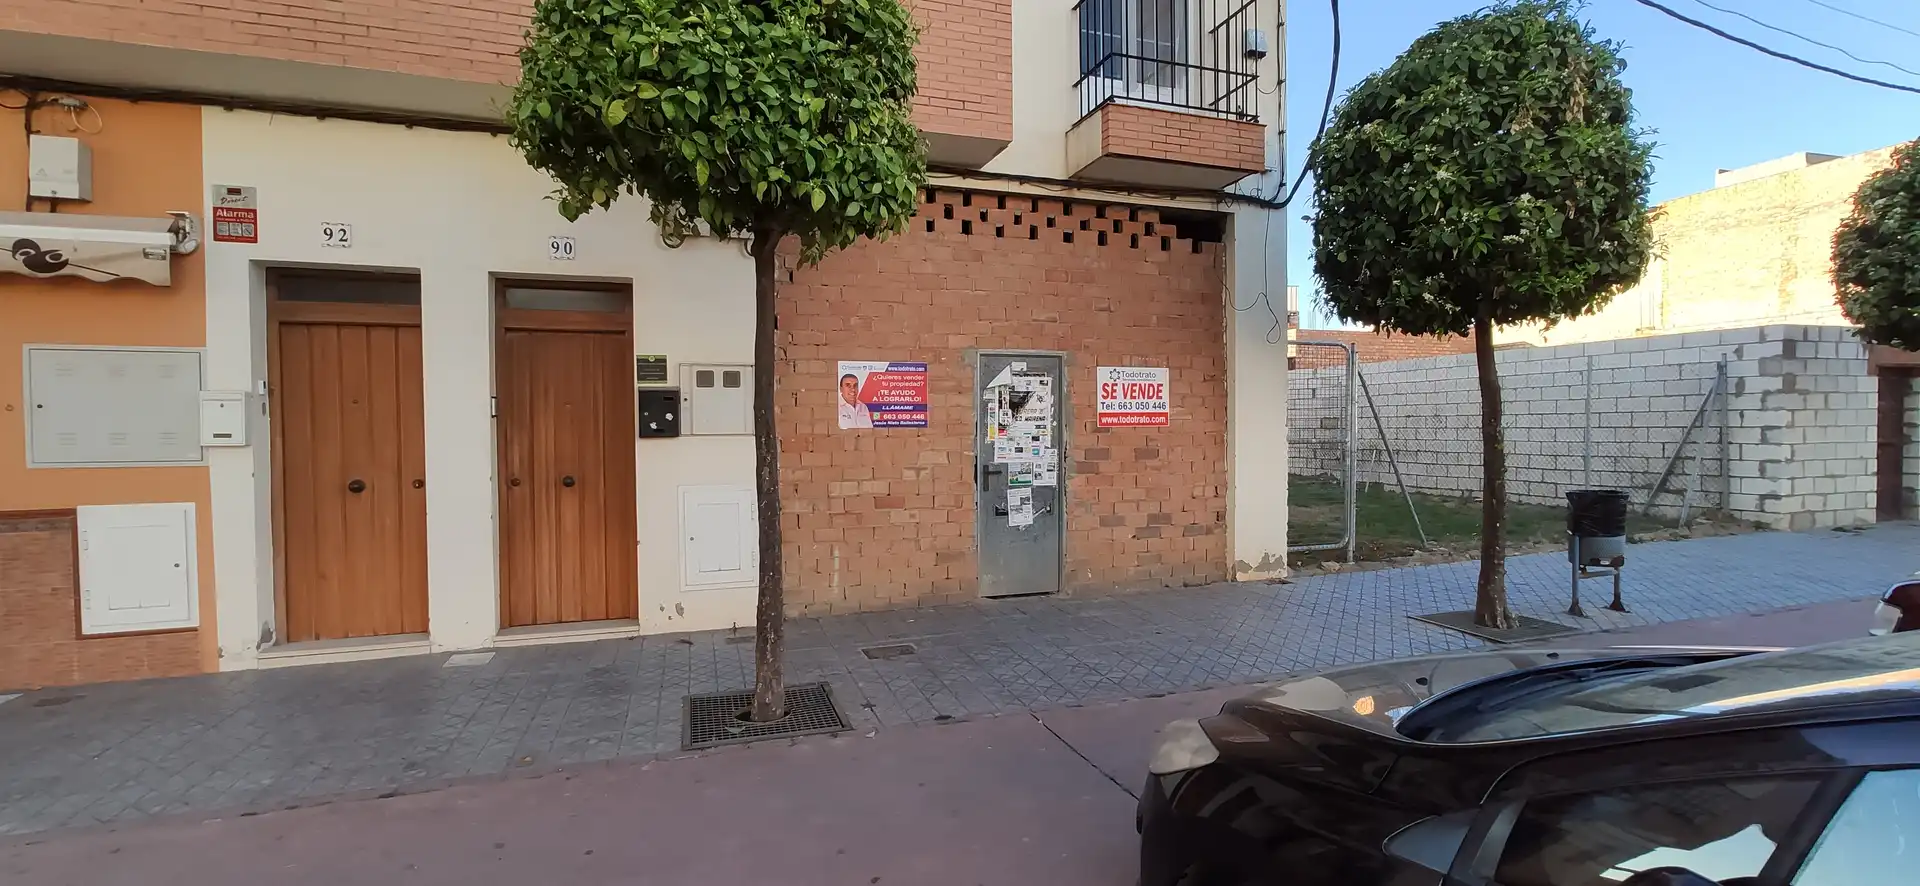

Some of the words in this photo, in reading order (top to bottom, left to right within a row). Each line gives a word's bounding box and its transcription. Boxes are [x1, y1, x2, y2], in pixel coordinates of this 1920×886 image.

[216, 208, 254, 218] Alarma
[323, 227, 348, 242] 92
[551, 240, 572, 255] 90
[1121, 370, 1157, 379] Todotrato
[1101, 383, 1118, 400] SE
[1122, 383, 1164, 400] VENDE
[1101, 402, 1115, 410] Tel:
[1118, 402, 1132, 410] 663
[1135, 402, 1149, 410] 050
[1152, 402, 1166, 410] 446
[1101, 415, 1166, 424] www.todotrato.com
